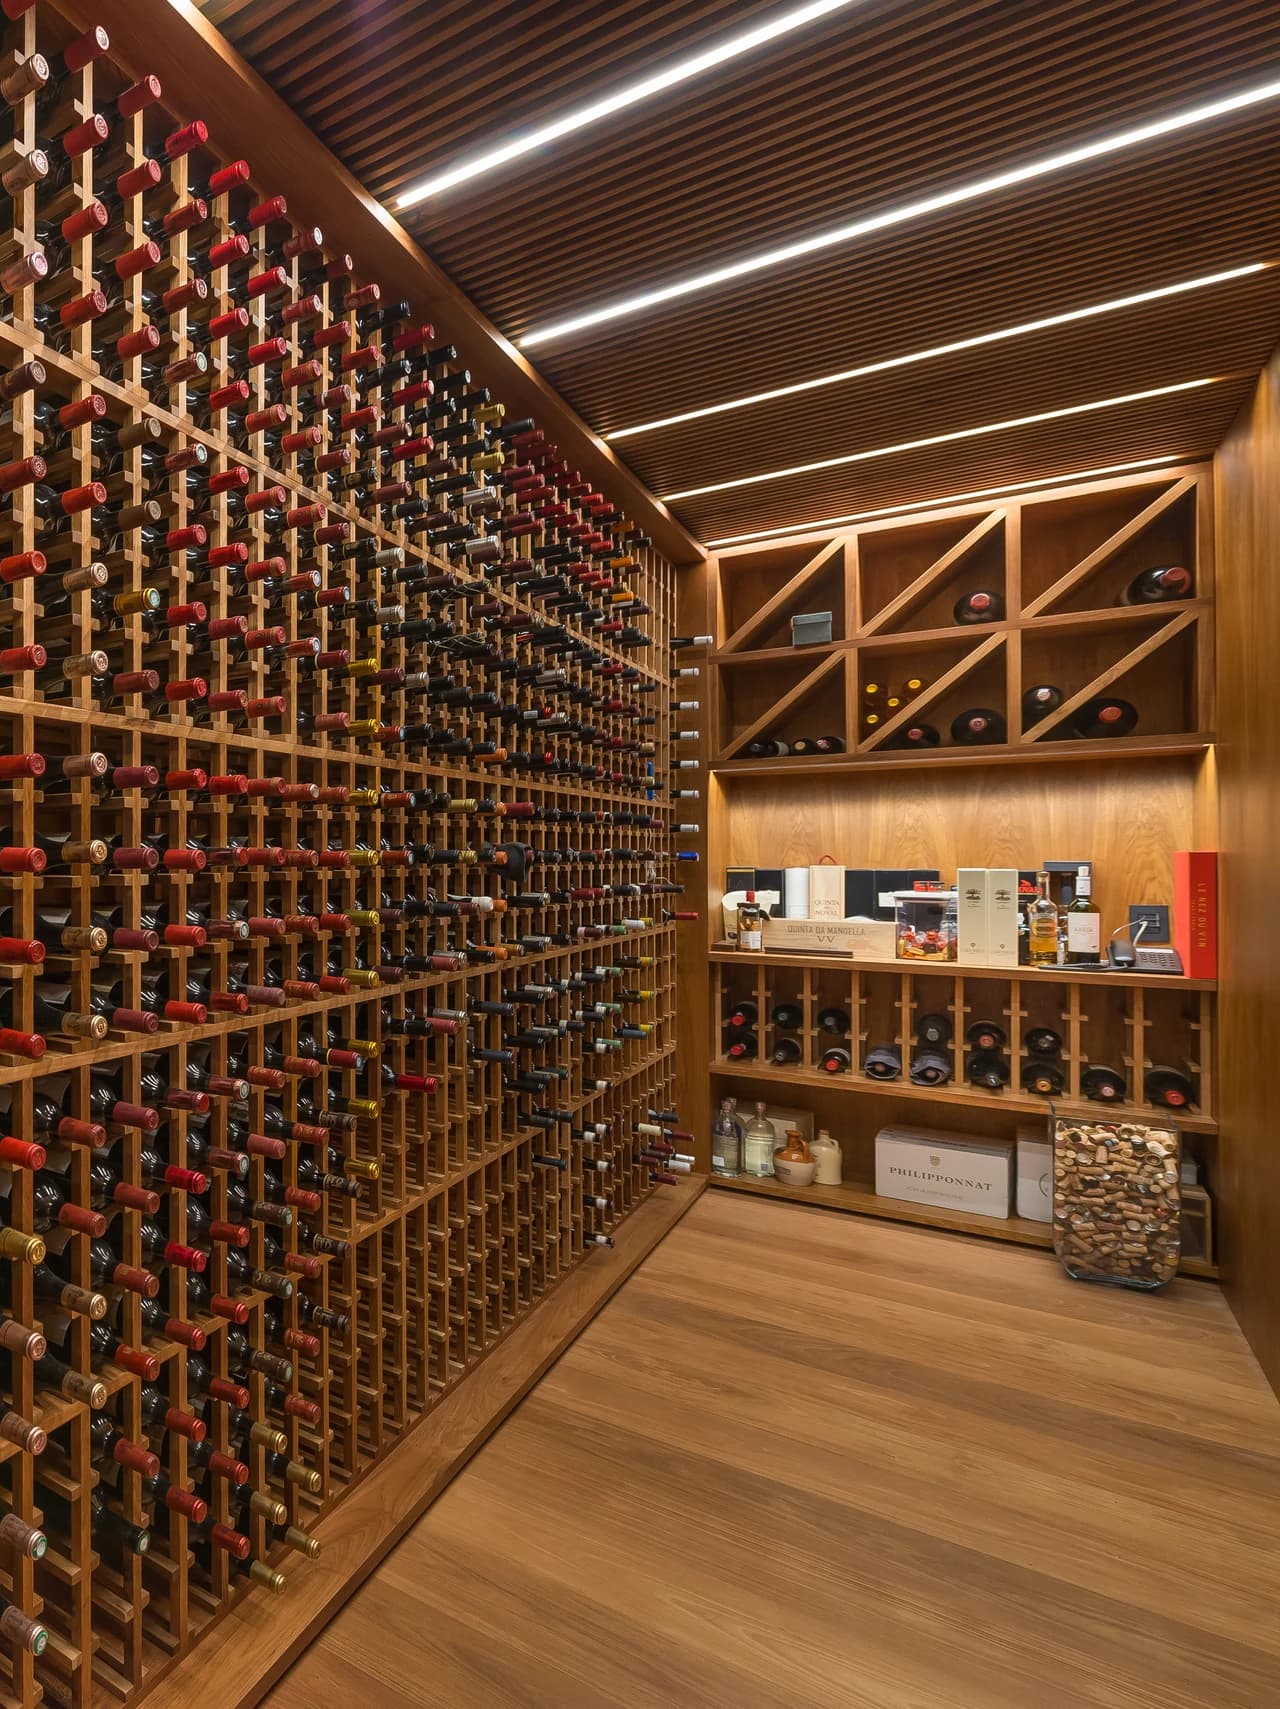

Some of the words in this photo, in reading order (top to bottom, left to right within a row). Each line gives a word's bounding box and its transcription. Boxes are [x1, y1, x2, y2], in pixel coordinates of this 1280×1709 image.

[787, 925, 814, 934] QUINTA
[815, 926, 826, 934] DA
[889, 1166, 993, 1191] PHILIPPONNAT
